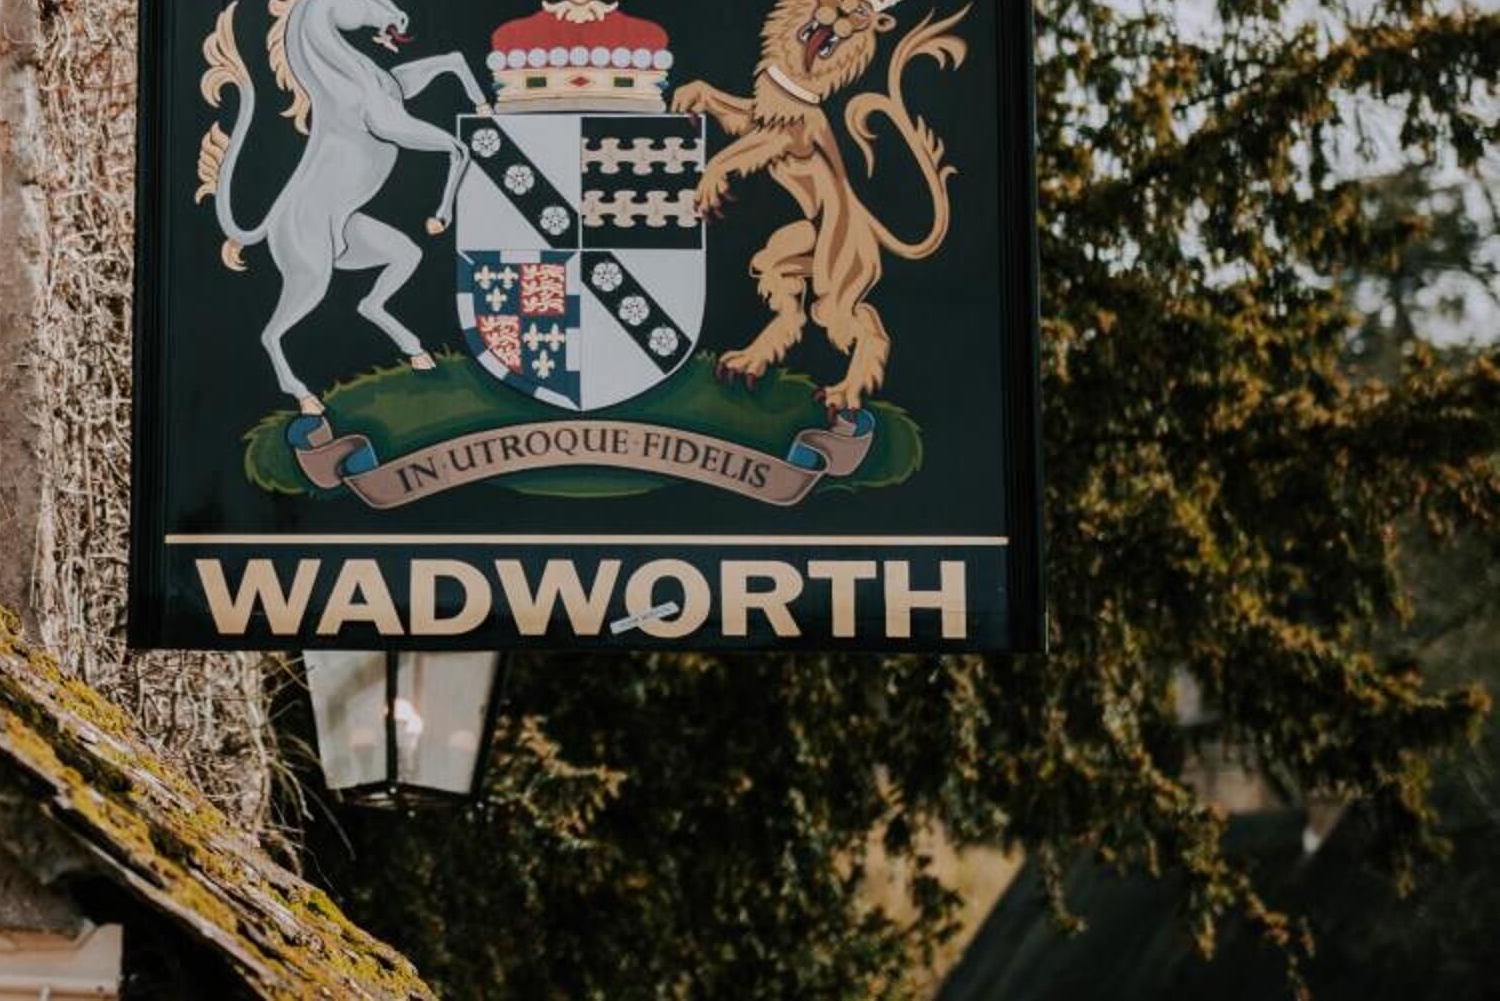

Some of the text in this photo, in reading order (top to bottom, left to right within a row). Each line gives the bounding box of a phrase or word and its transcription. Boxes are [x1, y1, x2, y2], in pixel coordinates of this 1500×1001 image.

[394, 428, 772, 494] IN UTROQUE FIDELIS
[195, 558, 966, 639] WADWORTH
